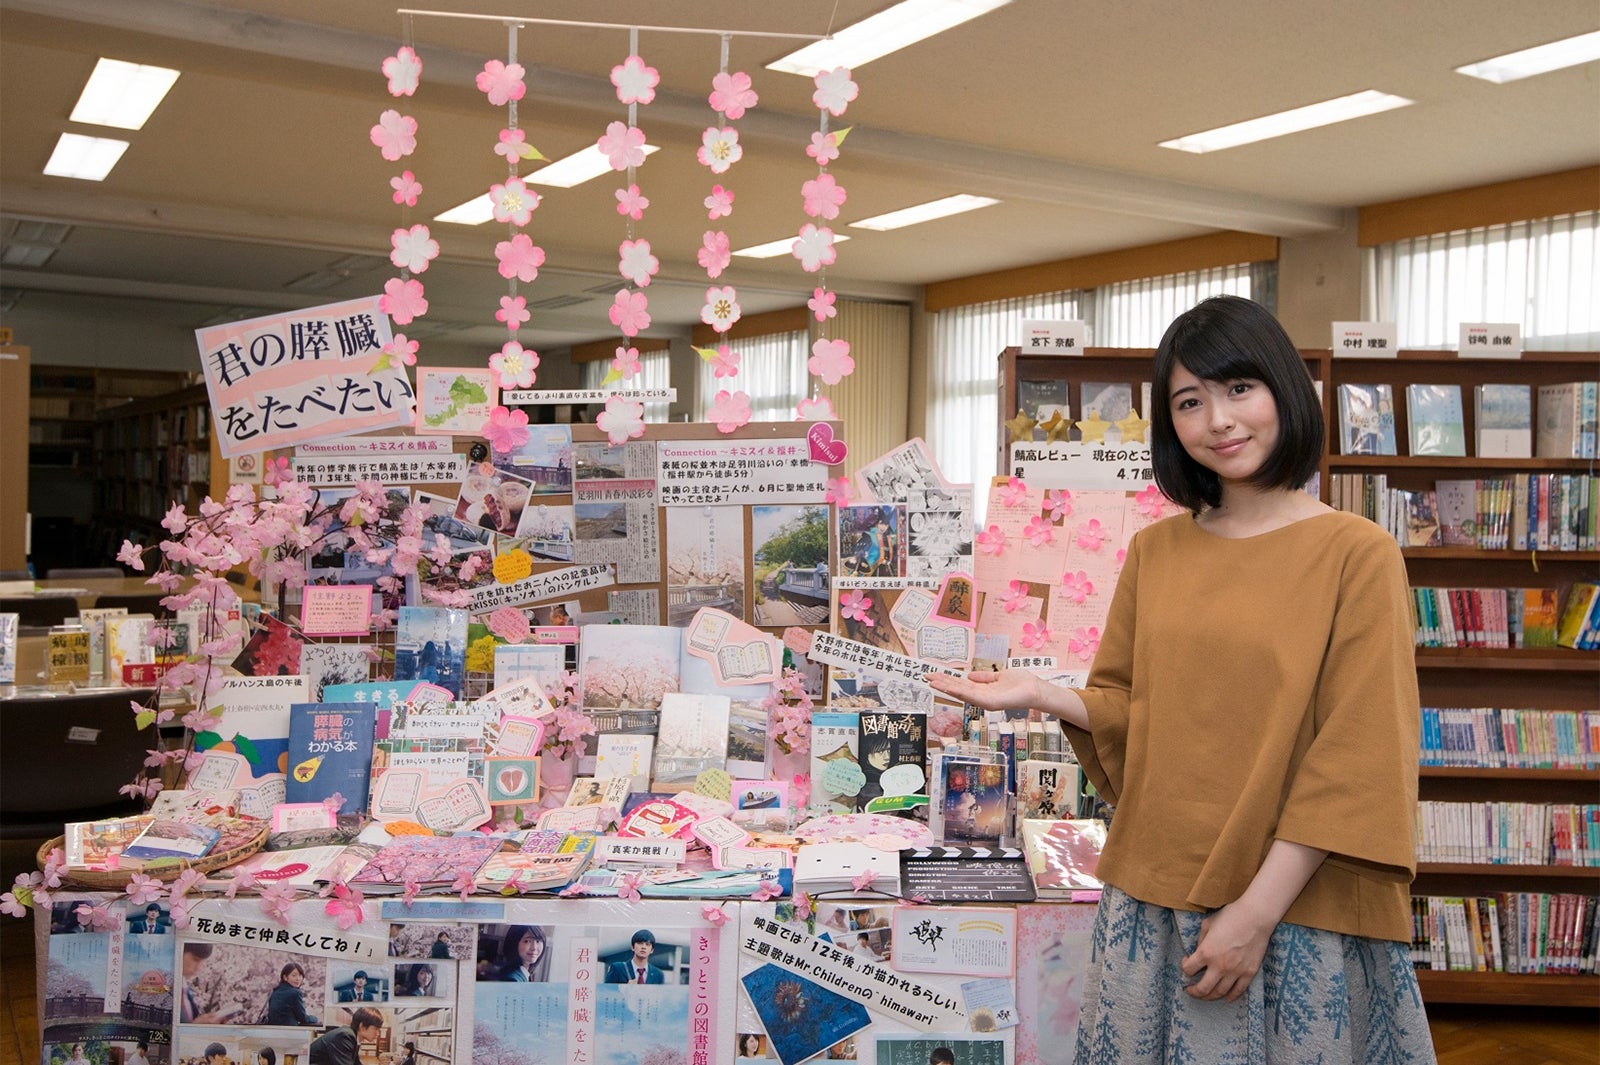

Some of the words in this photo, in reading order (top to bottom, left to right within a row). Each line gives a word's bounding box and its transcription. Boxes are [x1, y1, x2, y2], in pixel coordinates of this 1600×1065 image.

[1031, 337, 1050, 348] 宮下
[1055, 337, 1075, 348] 奈都
[1343, 339, 1362, 349] 中村
[1468, 335, 1488, 346] 谷崎
[209, 313, 382, 388] 君の膵臓
[220, 376, 414, 441] をたべたい
[302, 443, 356, 452] Connection
[664, 448, 717, 457] Connection
[810, 432, 838, 462] Kimisui
[1014, 450, 1081, 462] 鯖高レビュー
[1014, 467, 1025, 479] 星
[1011, 658, 1053, 668] 図書委員
[354, 689, 399, 703] 生きる
[314, 714, 354, 729] 膵臓の
[861, 714, 922, 742] 図書館奇譚
[314, 728, 353, 742] 病気が
[308, 740, 358, 753] わかる本
[188, 915, 374, 958] 「死ぬまで仲良くしてね！」
